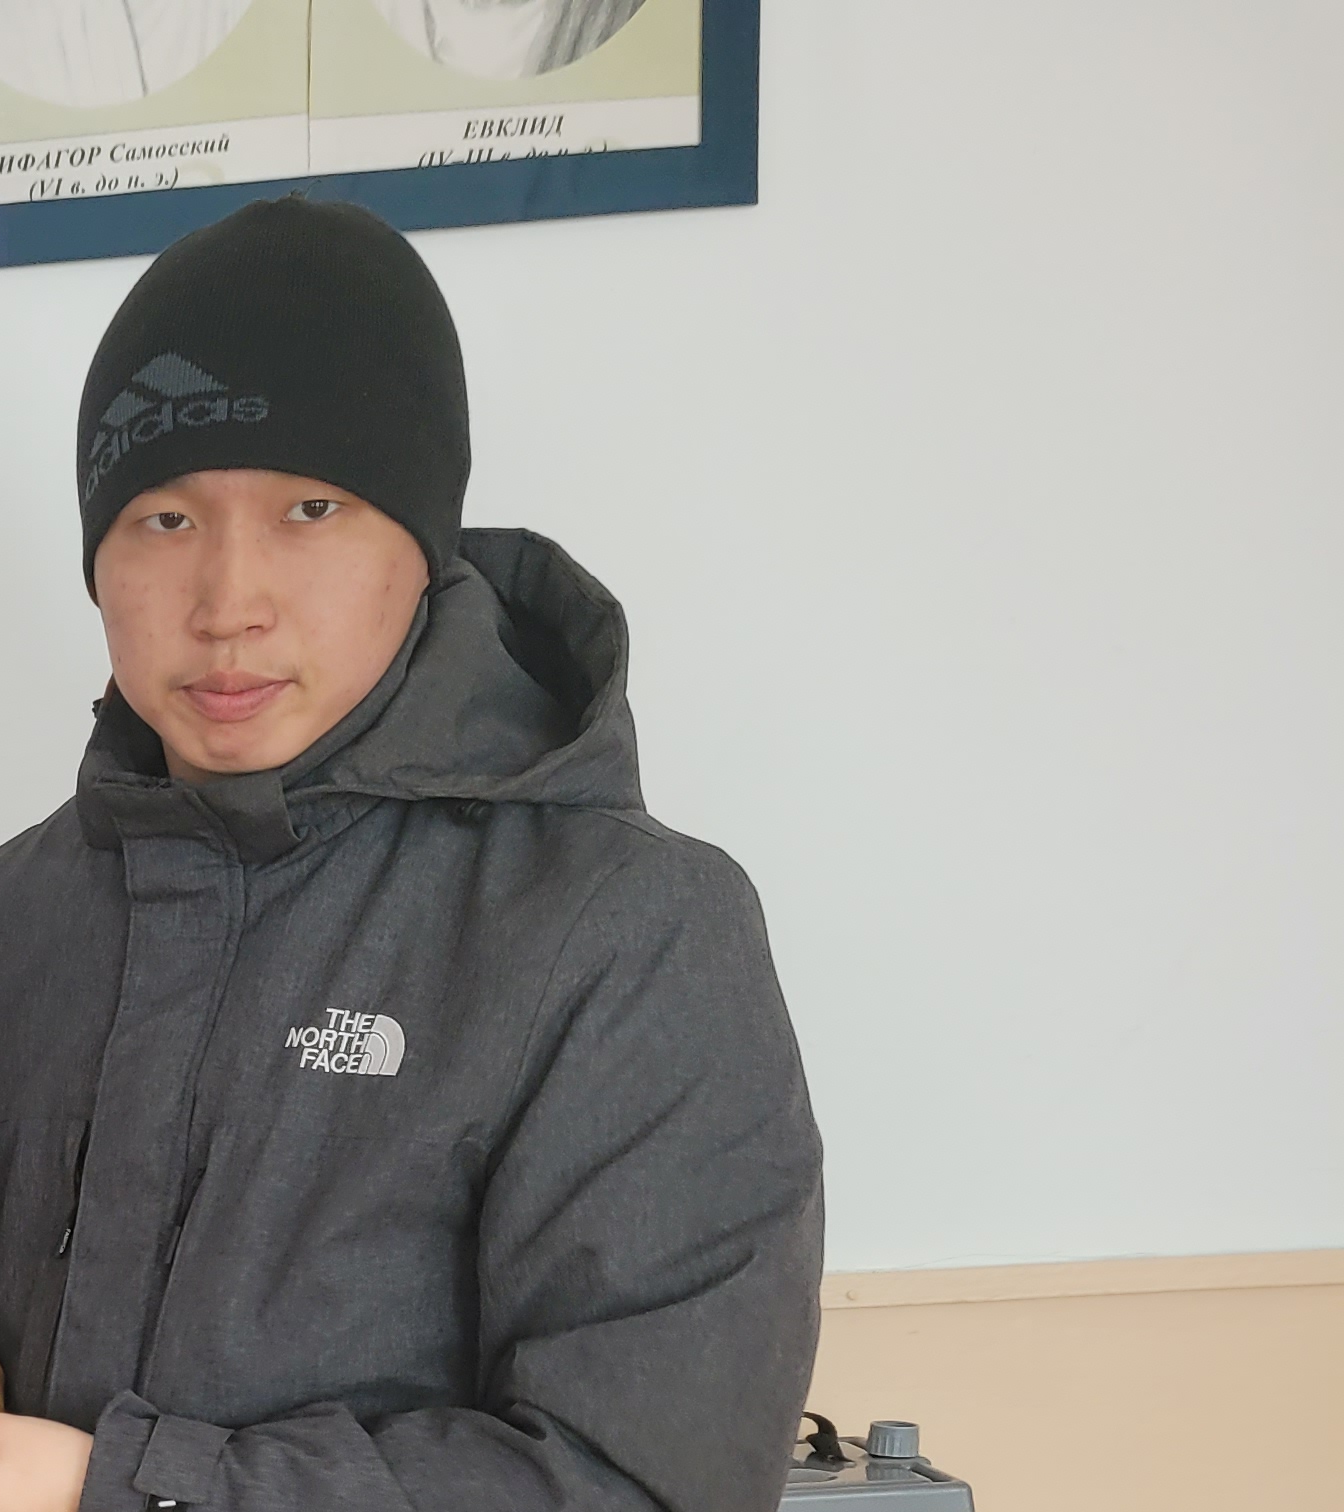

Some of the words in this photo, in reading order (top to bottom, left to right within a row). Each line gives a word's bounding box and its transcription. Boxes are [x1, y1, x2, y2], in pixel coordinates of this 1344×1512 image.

[463, 114, 564, 140] ЕВКЛИД
[109, 133, 230, 163] Самосский
[95, 173, 119, 193] до
[85, 397, 270, 501] adidas
[325, 1007, 375, 1033] THE
[284, 1026, 370, 1054] NORTH
[299, 1047, 362, 1075] FACE
